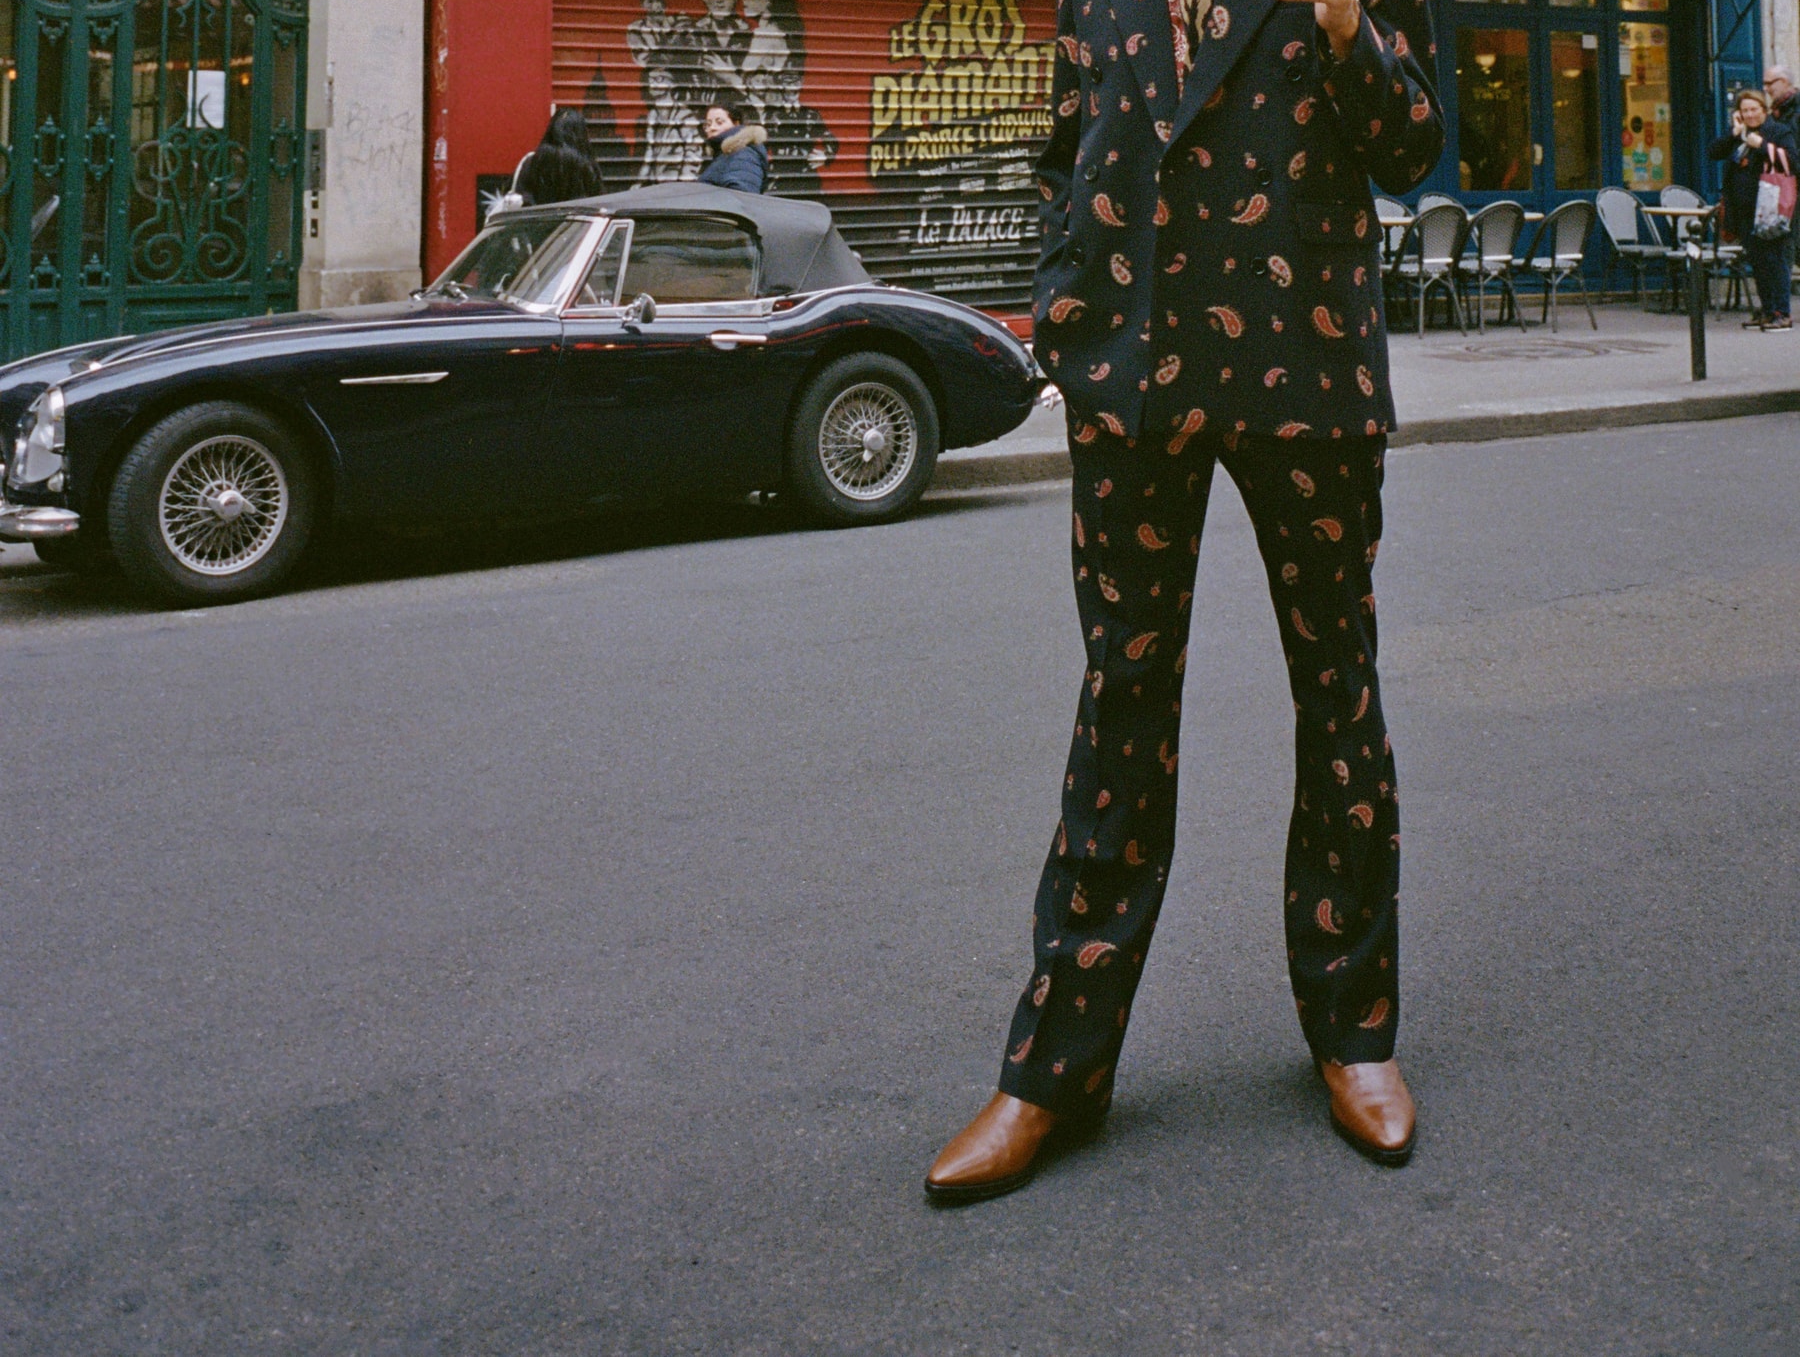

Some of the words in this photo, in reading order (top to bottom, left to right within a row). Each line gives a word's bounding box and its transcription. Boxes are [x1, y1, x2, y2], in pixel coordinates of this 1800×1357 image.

[890, 23, 916, 63] LE
[871, 42, 1056, 138] DIAMANT
[870, 144, 901, 178] DU
[904, 126, 976, 167] PRINCE
[978, 109, 1055, 148] LUDWIG
[946, 204, 1025, 243] PALACE
